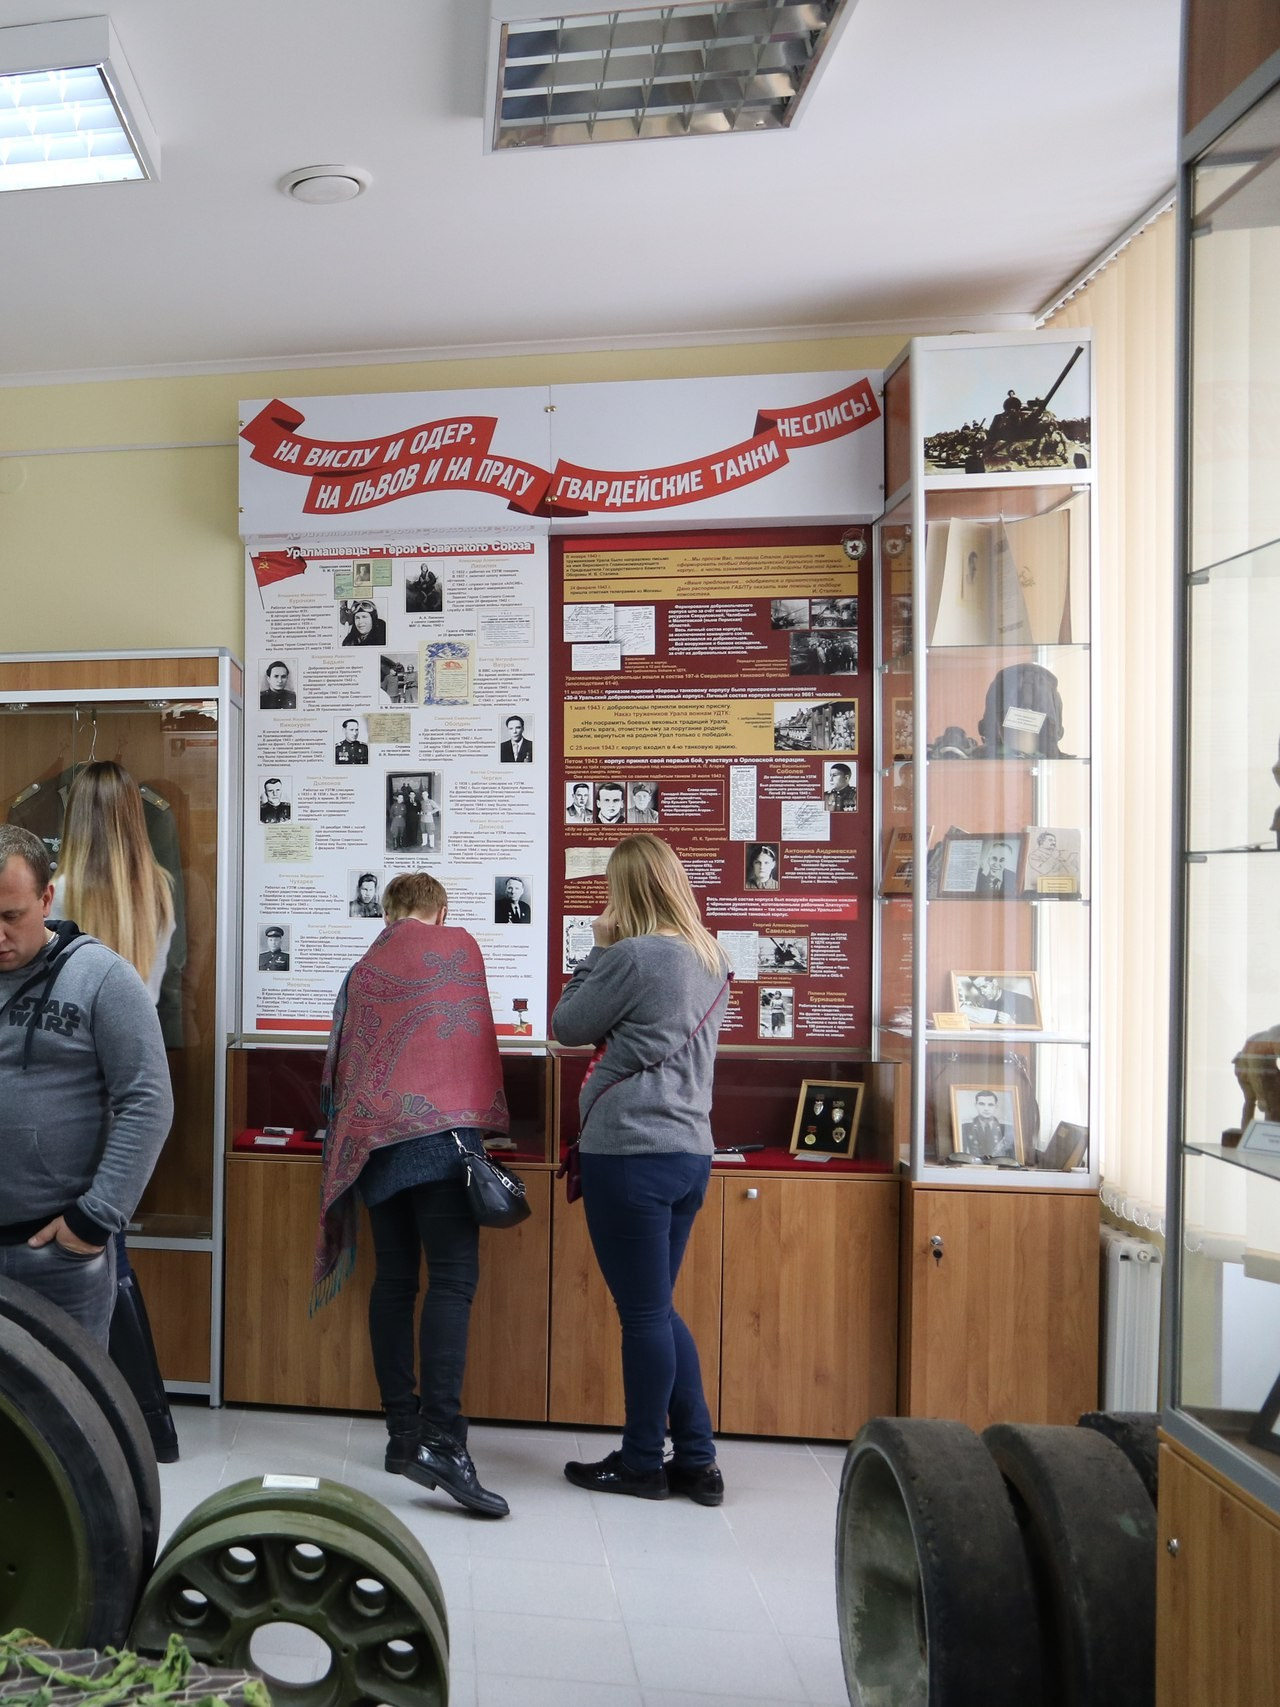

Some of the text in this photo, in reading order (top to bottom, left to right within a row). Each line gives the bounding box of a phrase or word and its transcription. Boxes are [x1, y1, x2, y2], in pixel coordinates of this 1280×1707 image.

[776, 392, 872, 438] НЕСЛИСЬ!
[273, 423, 476, 468] НА ВИСЛУ И ОДЕР,
[314, 456, 535, 509] НА ЛЬВОВ И НА ПРАГУ
[556, 440, 779, 506] ГВАРДЕЙСКИЕ ТАНКИ
[287, 541, 531, 559] Уралмашевцы Герои Советского Союза
